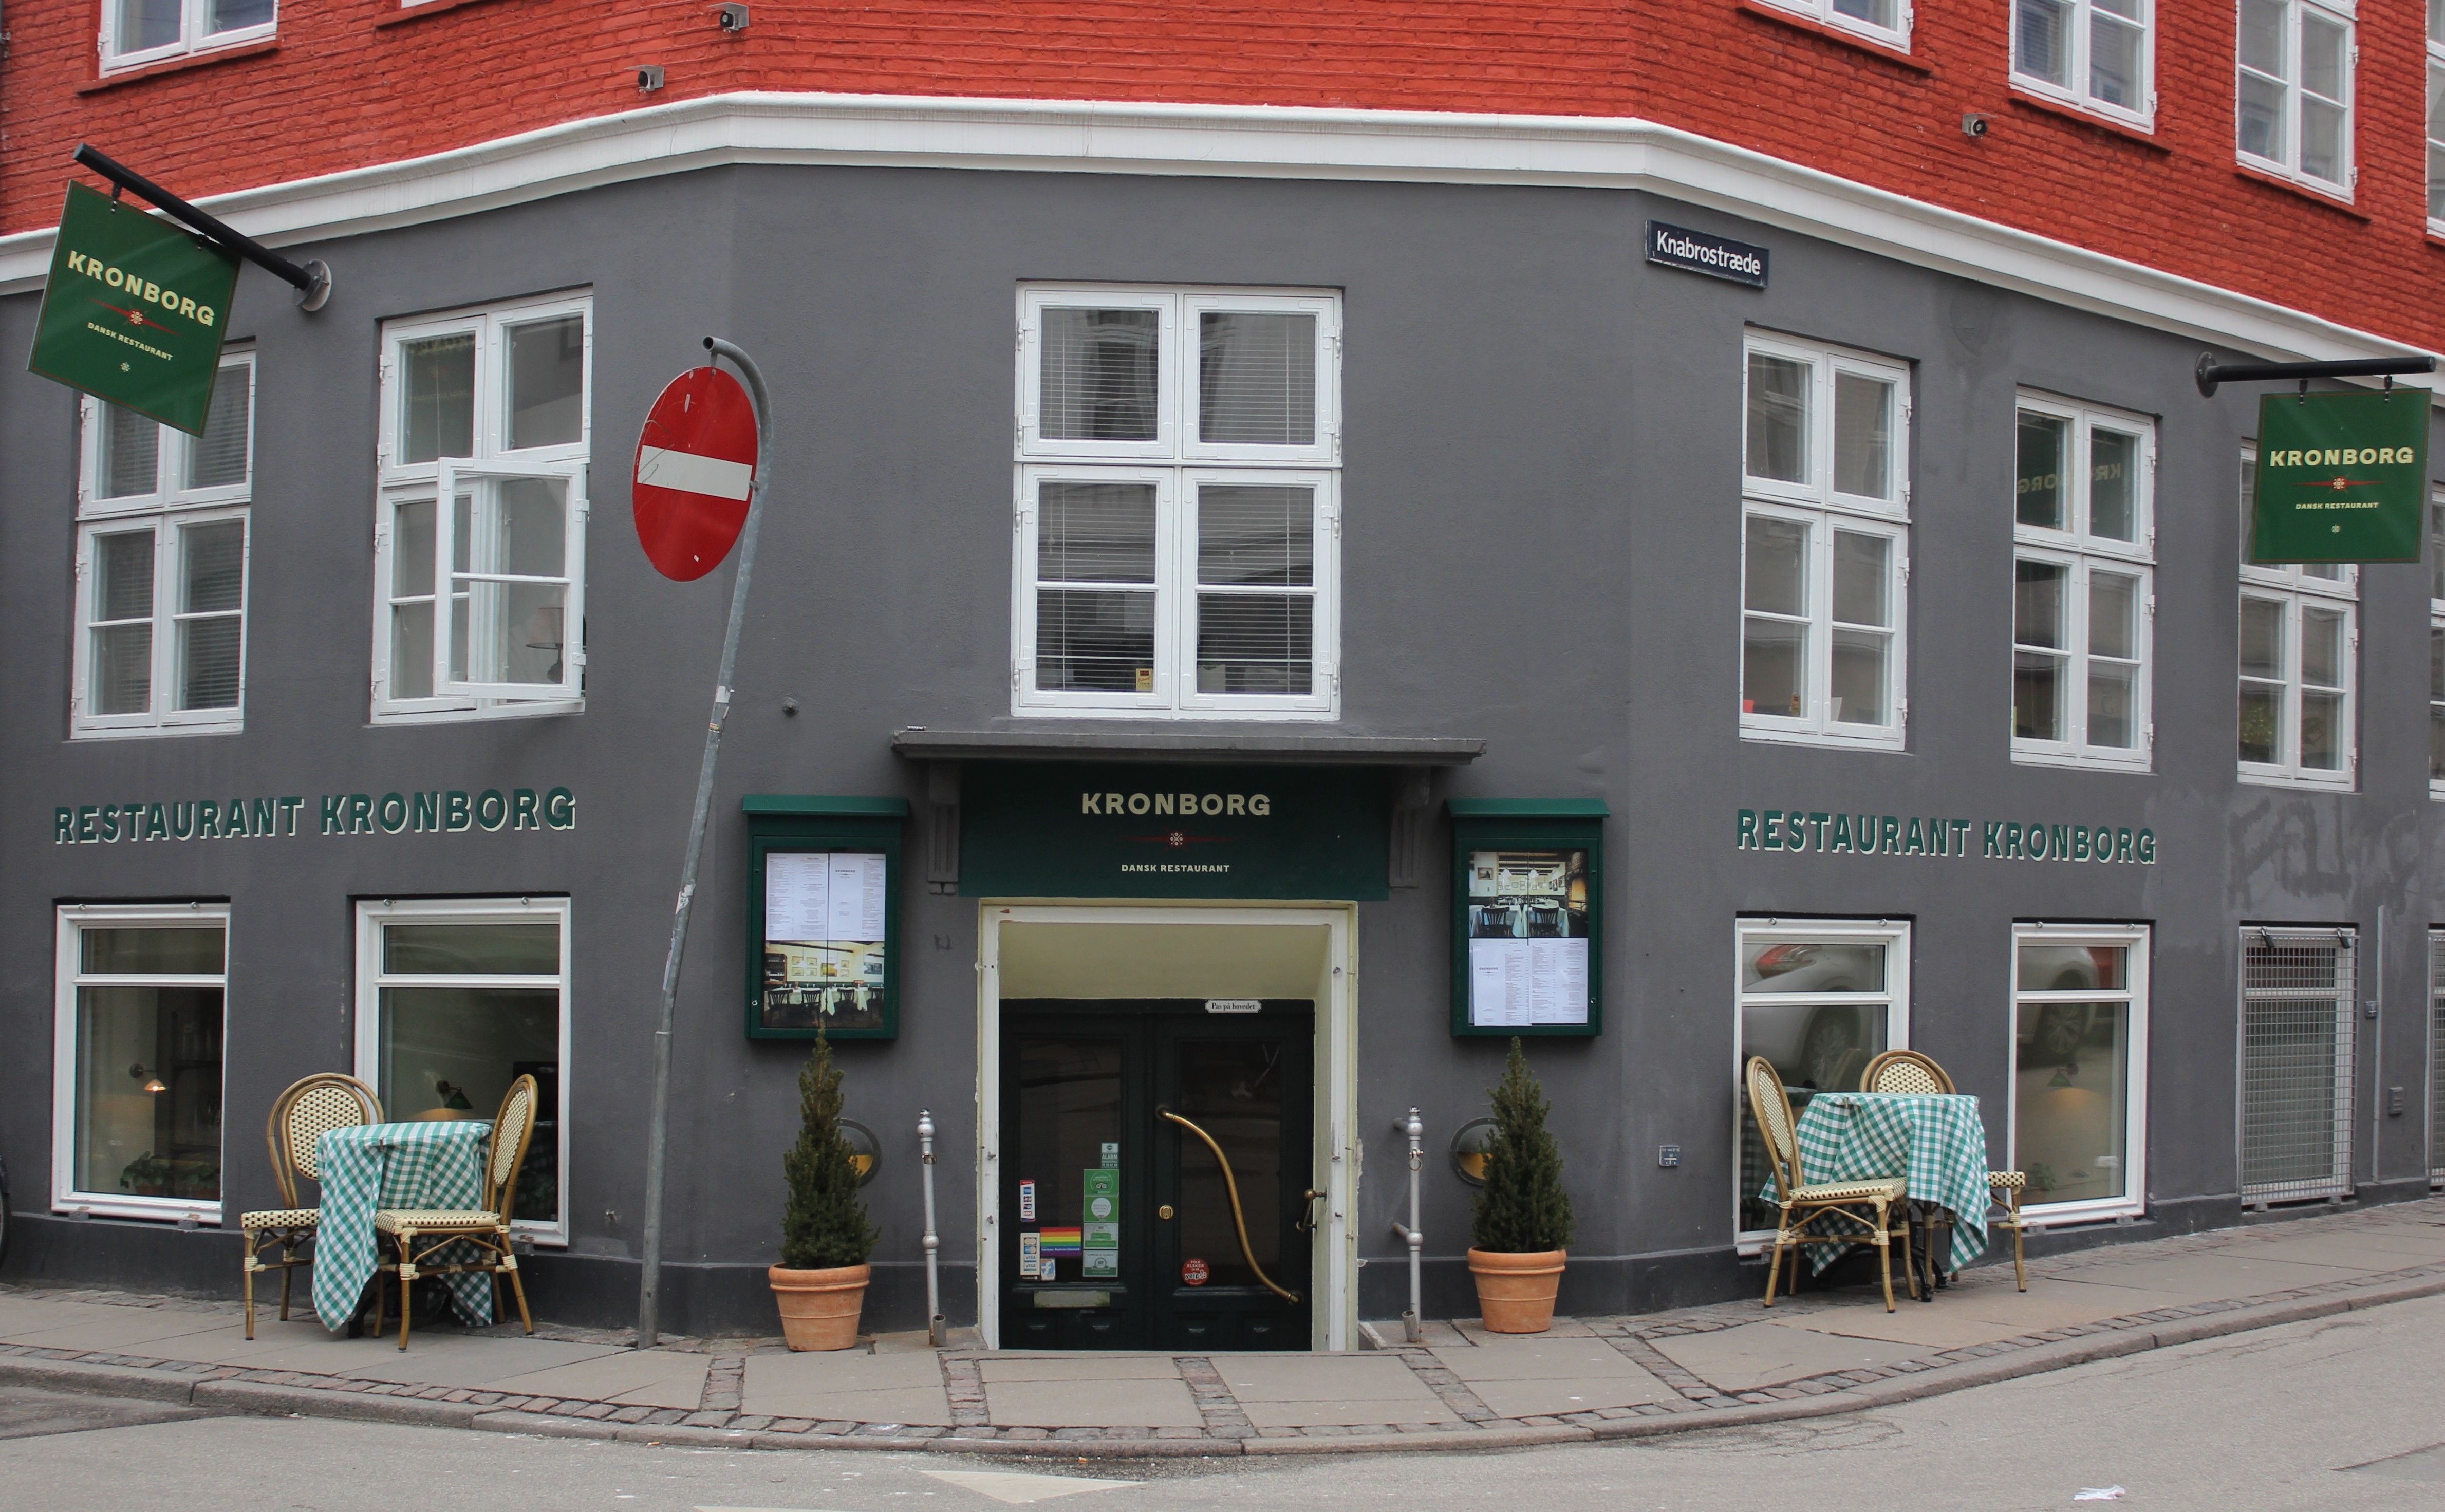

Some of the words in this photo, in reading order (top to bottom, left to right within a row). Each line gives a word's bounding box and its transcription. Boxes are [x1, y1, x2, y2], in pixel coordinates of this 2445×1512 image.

[1656, 230, 1761, 276] Knabrostræde
[67, 250, 215, 327] KRONBORG
[87, 322, 117, 339] DANSK
[118, 334, 173, 361] RESTAURANT
[2269, 447, 2414, 467] KRONBORG
[54, 796, 305, 845] RESTAURANT
[321, 787, 576, 835] KRONBORG
[1082, 793, 1271, 815] KRONBORG
[1737, 809, 1971, 858] RESTAURANT
[1983, 821, 2156, 865] KRONBORG
[1121, 864, 1157, 872] DANSK
[1223, 1002, 1230, 1011] på
